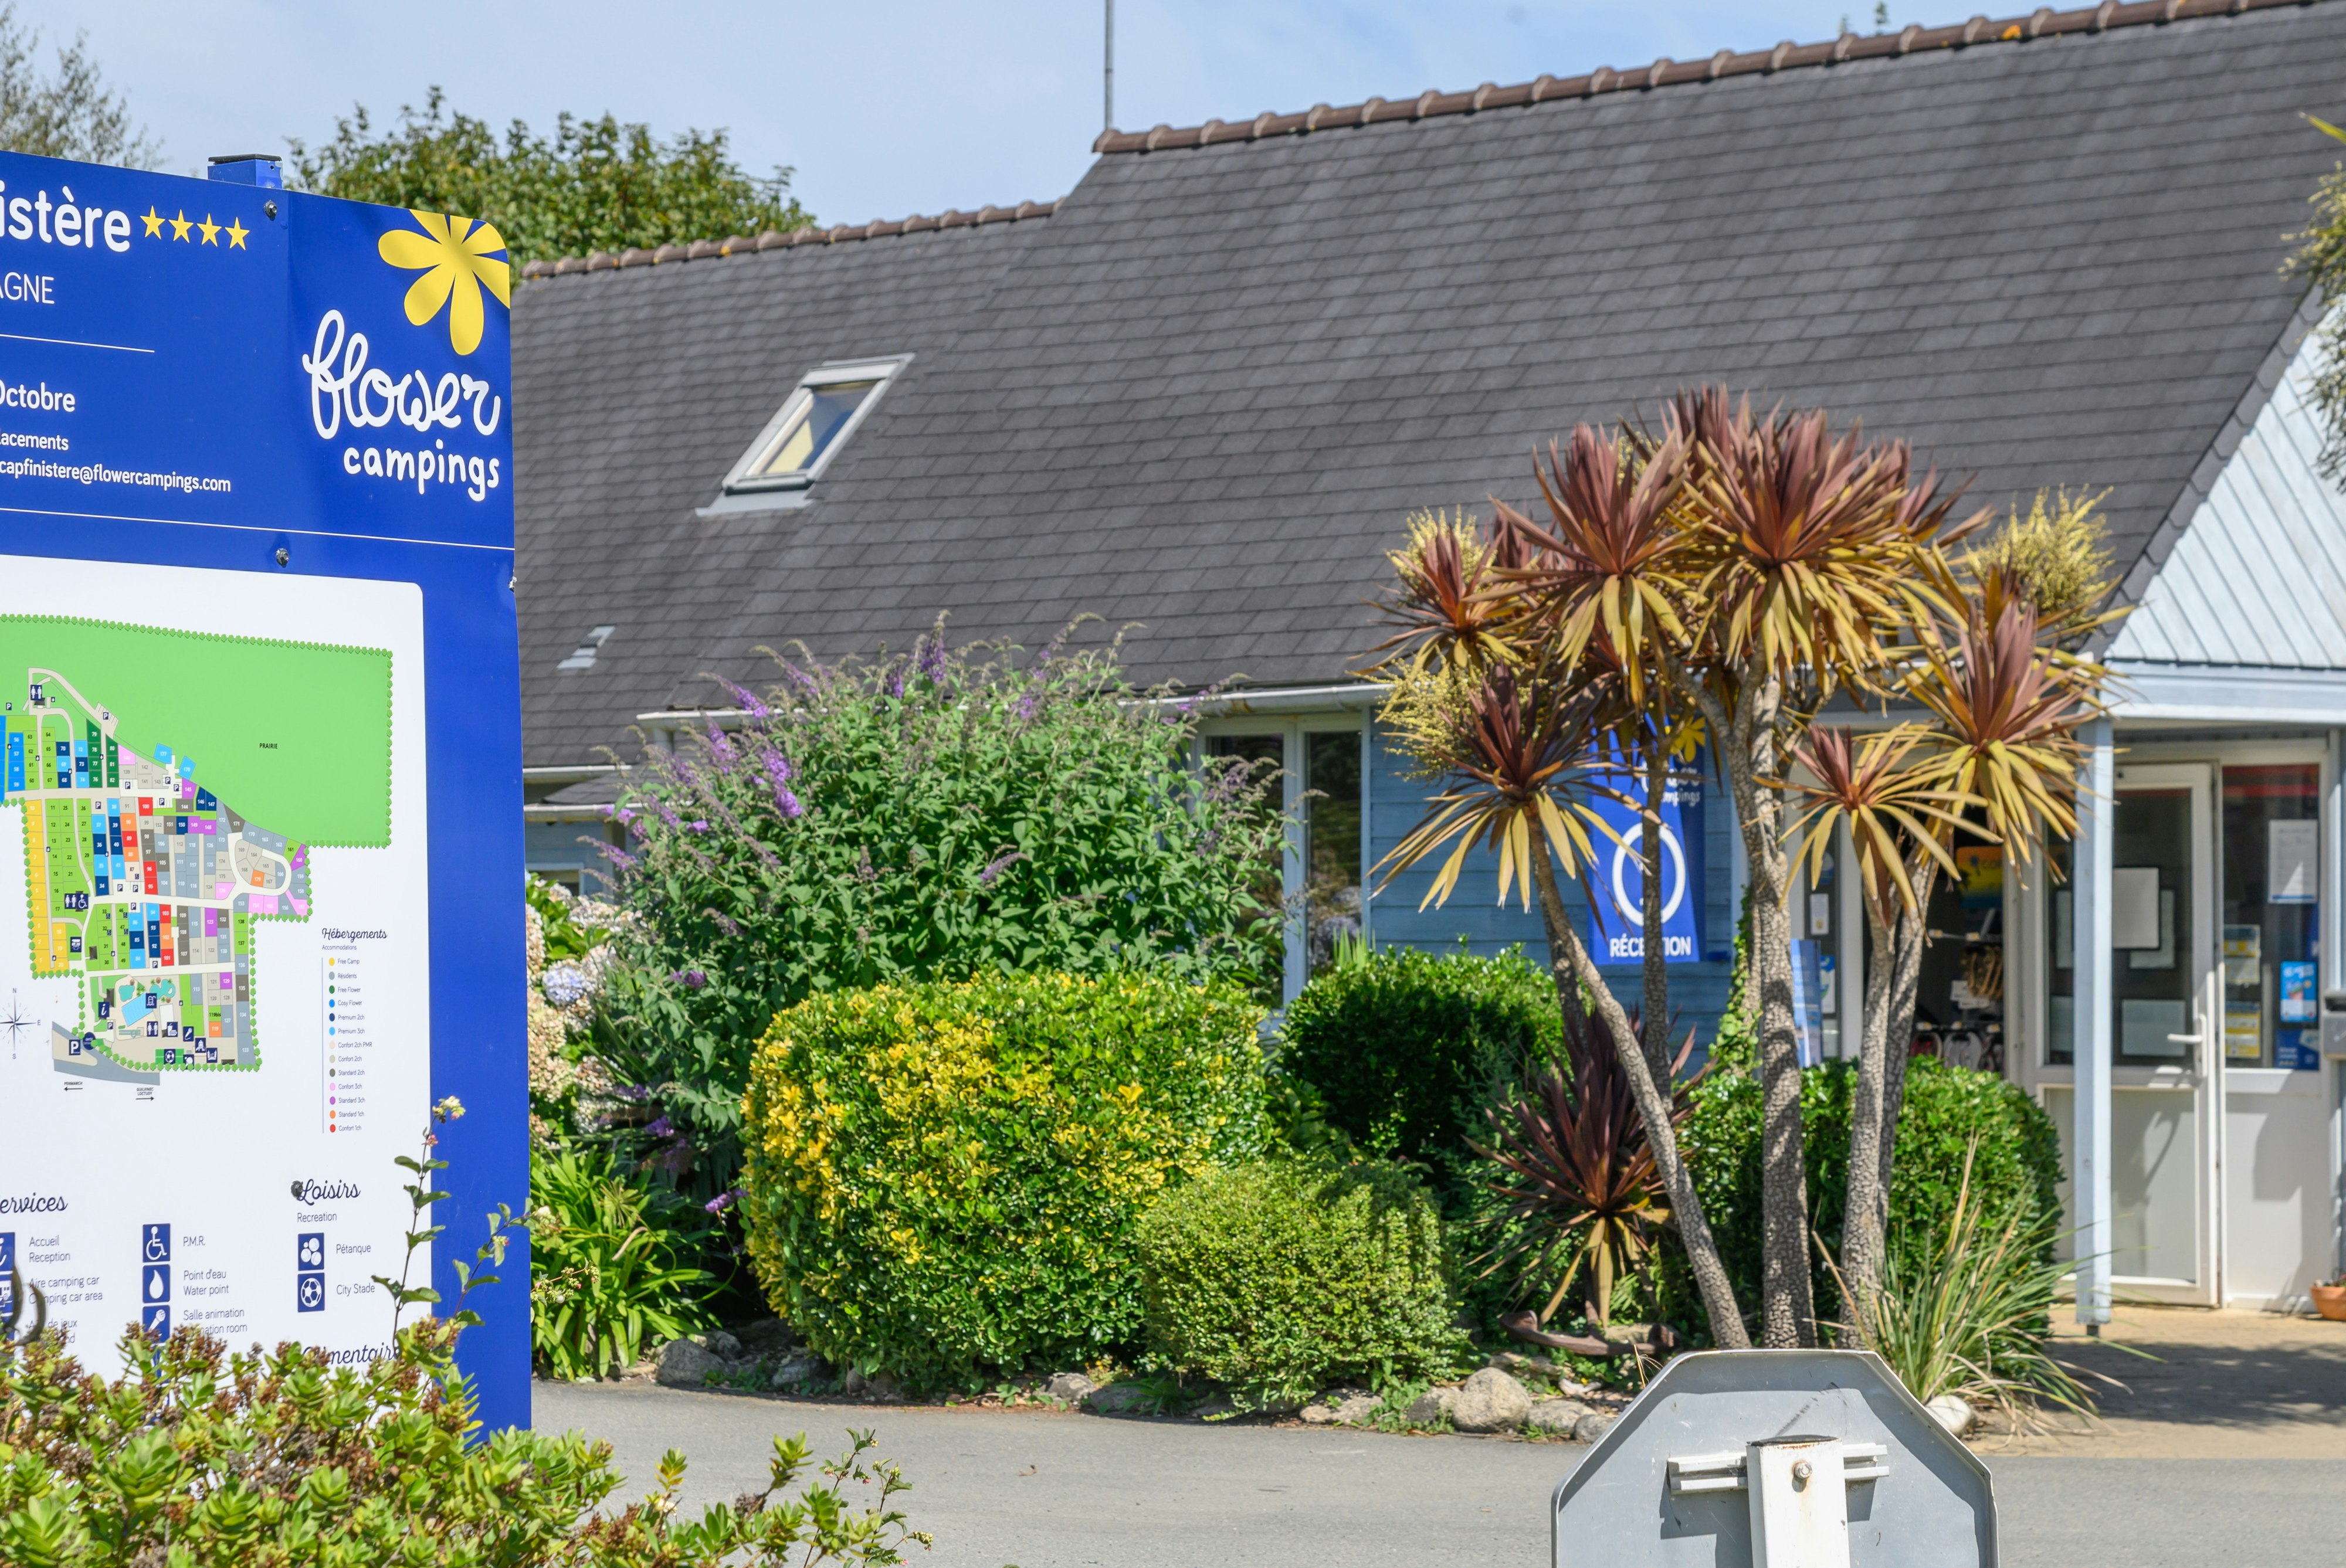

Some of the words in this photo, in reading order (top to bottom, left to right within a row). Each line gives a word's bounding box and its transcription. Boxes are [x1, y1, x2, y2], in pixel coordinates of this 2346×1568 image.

[0, 272, 55, 304] GNE
[302, 309, 501, 439] flower
[0, 427, 69, 451] acements
[0, 458, 230, 493] capfinistere@flowercampings.com
[344, 439, 499, 502] campings
[1660, 788, 1700, 807] mpings
[322, 928, 388, 943] Hébergements
[1609, 933, 1691, 958] RÉCEION
[297, 1179, 361, 1206] Loisirs
[297, 1212, 337, 1223] Recreation
[29, 1235, 60, 1247] Accueil
[183, 1236, 205, 1247] P.M.R.
[336, 1244, 371, 1255] Pétanque
[29, 1251, 70, 1264] Reception
[183, 1270, 204, 1281] Point
[206, 1269, 226, 1279] d'eau
[29, 1278, 46, 1288] Aire
[48, 1277, 84, 1288] camping
[86, 1277, 100, 1285] car
[183, 1285, 206, 1296] Water
[209, 1285, 229, 1297] point
[336, 1284, 351, 1297] City
[353, 1283, 375, 1294] Stade
[69, 1292, 82, 1302] car
[85, 1292, 103, 1301] area
[183, 1309, 203, 1321] Salle
[205, 1308, 245, 1319] animation
[48, 1318, 58, 1328] de
[226, 1324, 248, 1333] room
